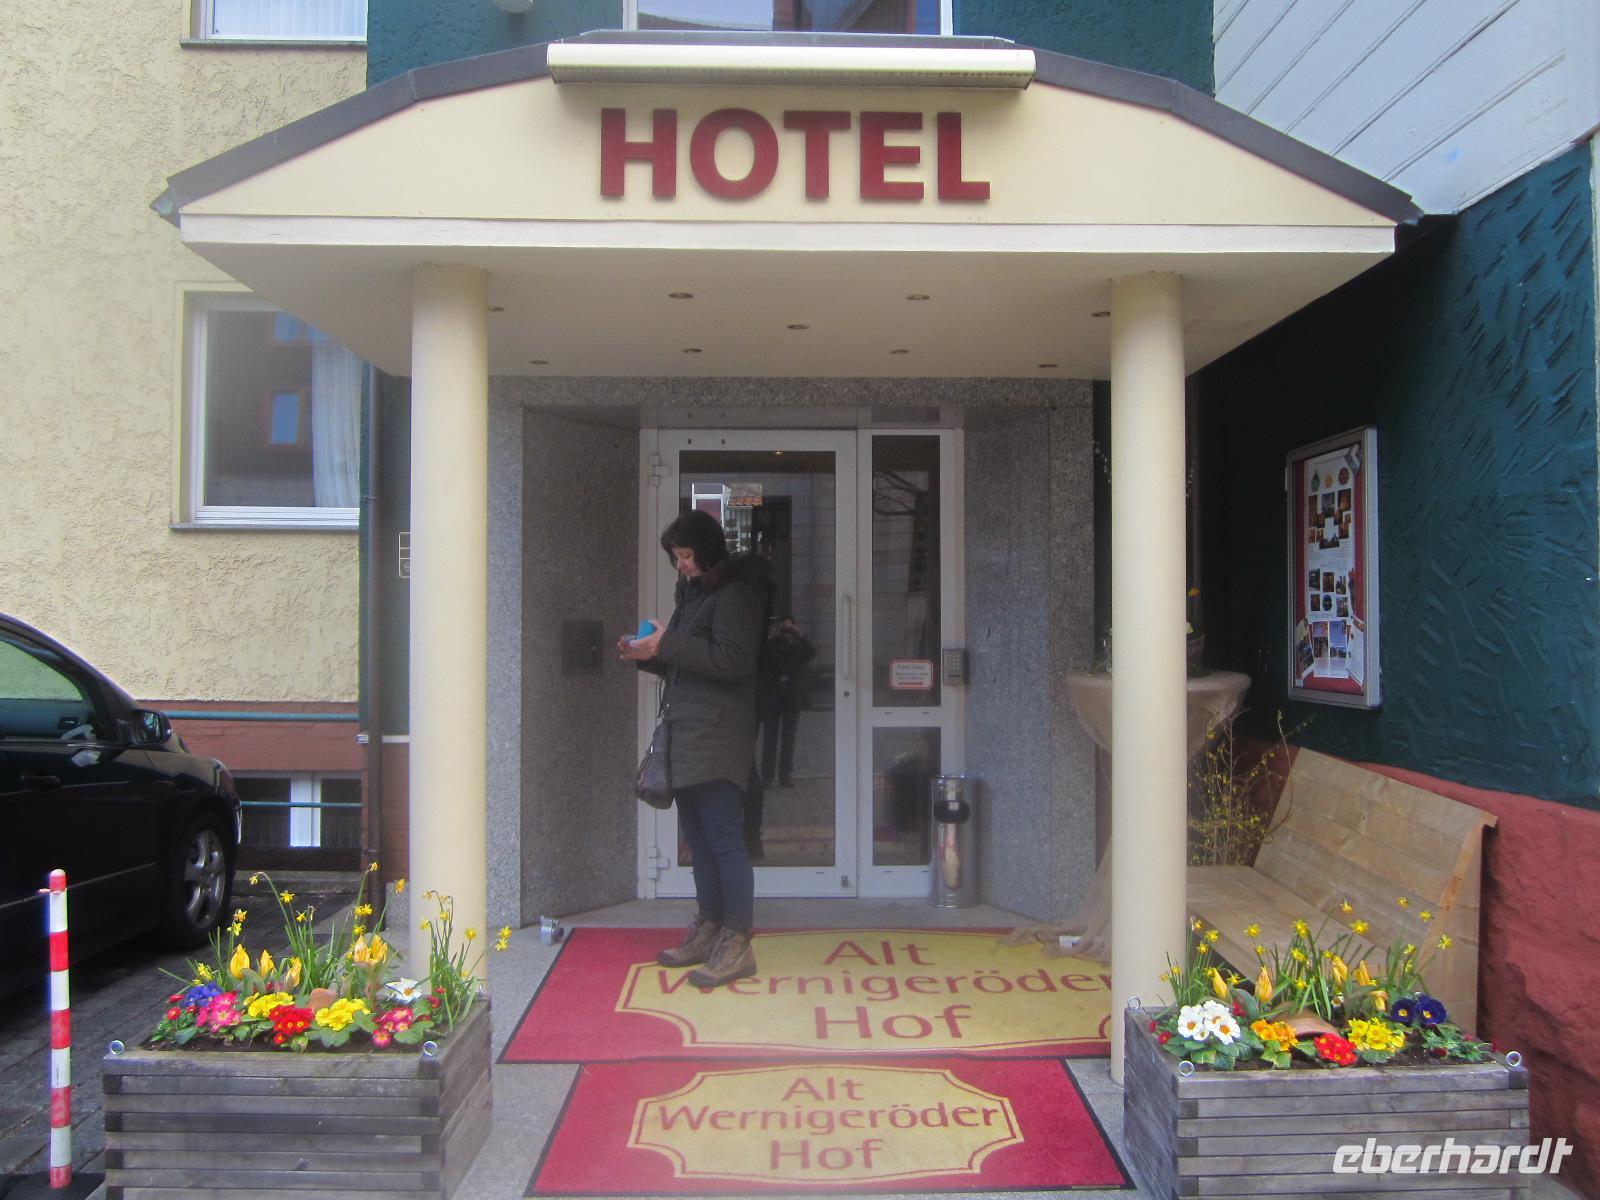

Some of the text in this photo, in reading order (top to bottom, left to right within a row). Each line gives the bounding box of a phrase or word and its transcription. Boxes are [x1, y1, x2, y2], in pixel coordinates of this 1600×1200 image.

[600, 107, 991, 200] HOTEL
[823, 940, 935, 966] Alt
[814, 1005, 972, 1040] Hof
[781, 1076, 865, 1101] Alt
[658, 1102, 1000, 1135] Wernigeröder
[769, 1138, 883, 1171] Hof
